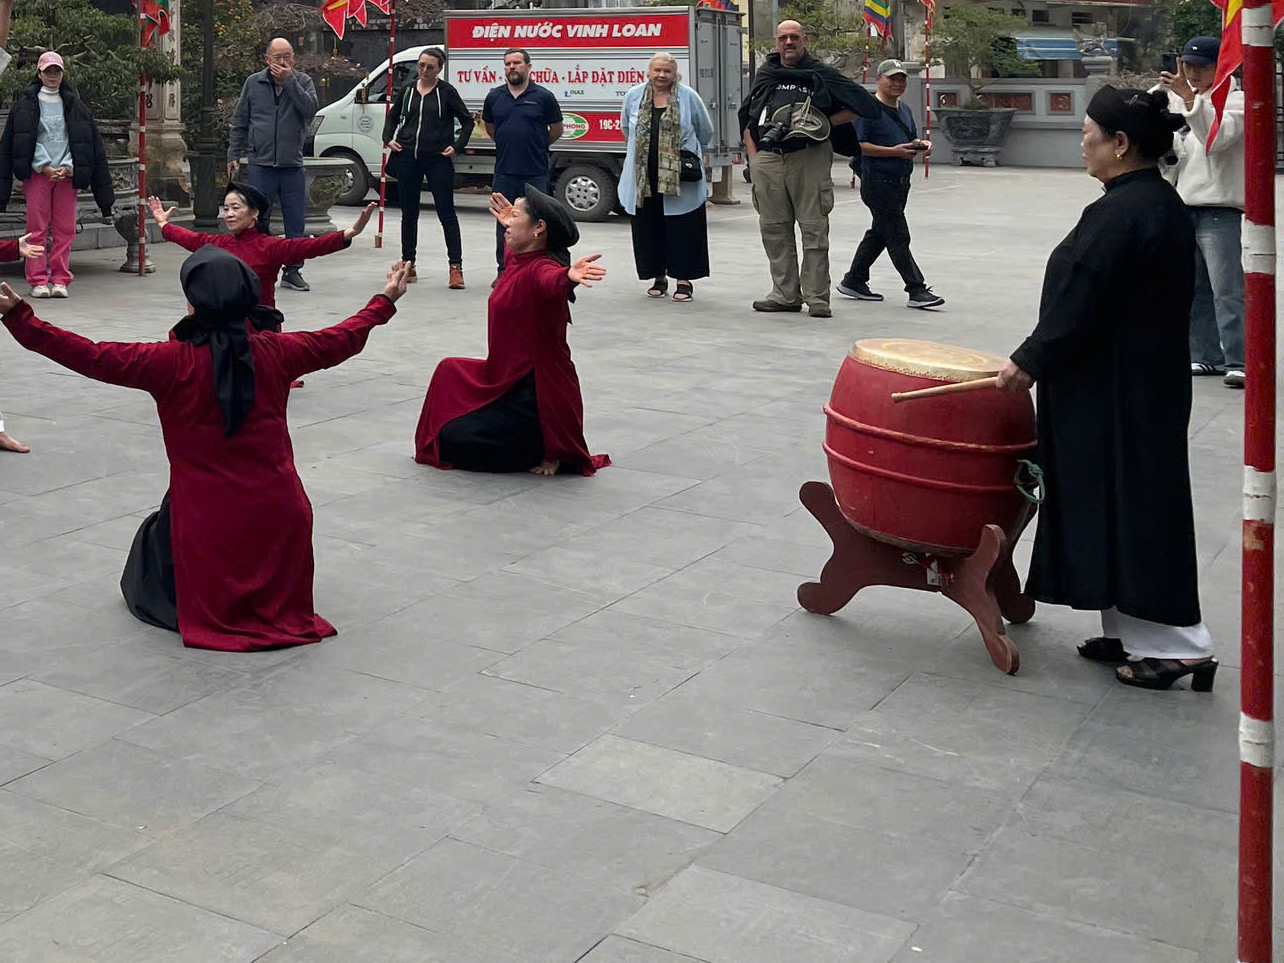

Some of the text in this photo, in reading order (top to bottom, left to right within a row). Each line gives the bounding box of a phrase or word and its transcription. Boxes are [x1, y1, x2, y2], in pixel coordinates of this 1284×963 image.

[472, 21, 662, 42] ĐIỆN NƯỚC VINH LOAN
[457, 68, 472, 83] TƯ
[599, 119, 621, 130] 19C-2
